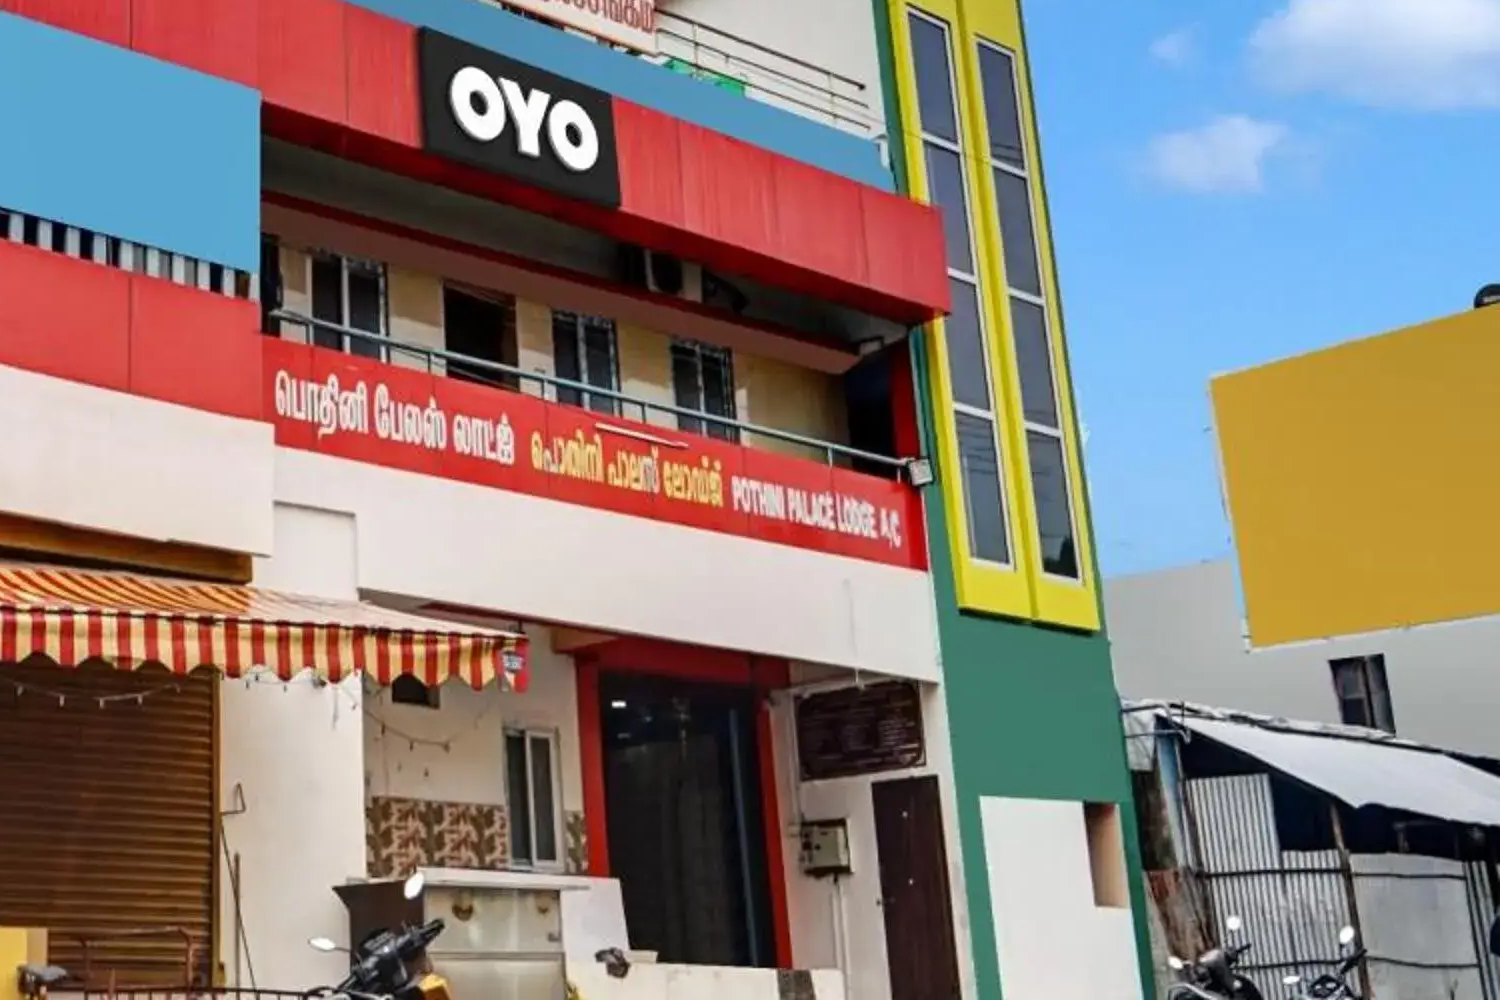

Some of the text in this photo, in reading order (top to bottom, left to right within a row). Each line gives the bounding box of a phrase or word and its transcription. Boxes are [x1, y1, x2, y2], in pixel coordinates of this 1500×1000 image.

[450, 66, 599, 172] OYO
[374, 383, 448, 449] பேலஸ்
[731, 475, 786, 520] POTHINI
[787, 487, 836, 531] PALACE
[835, 491, 878, 539] LODGE
